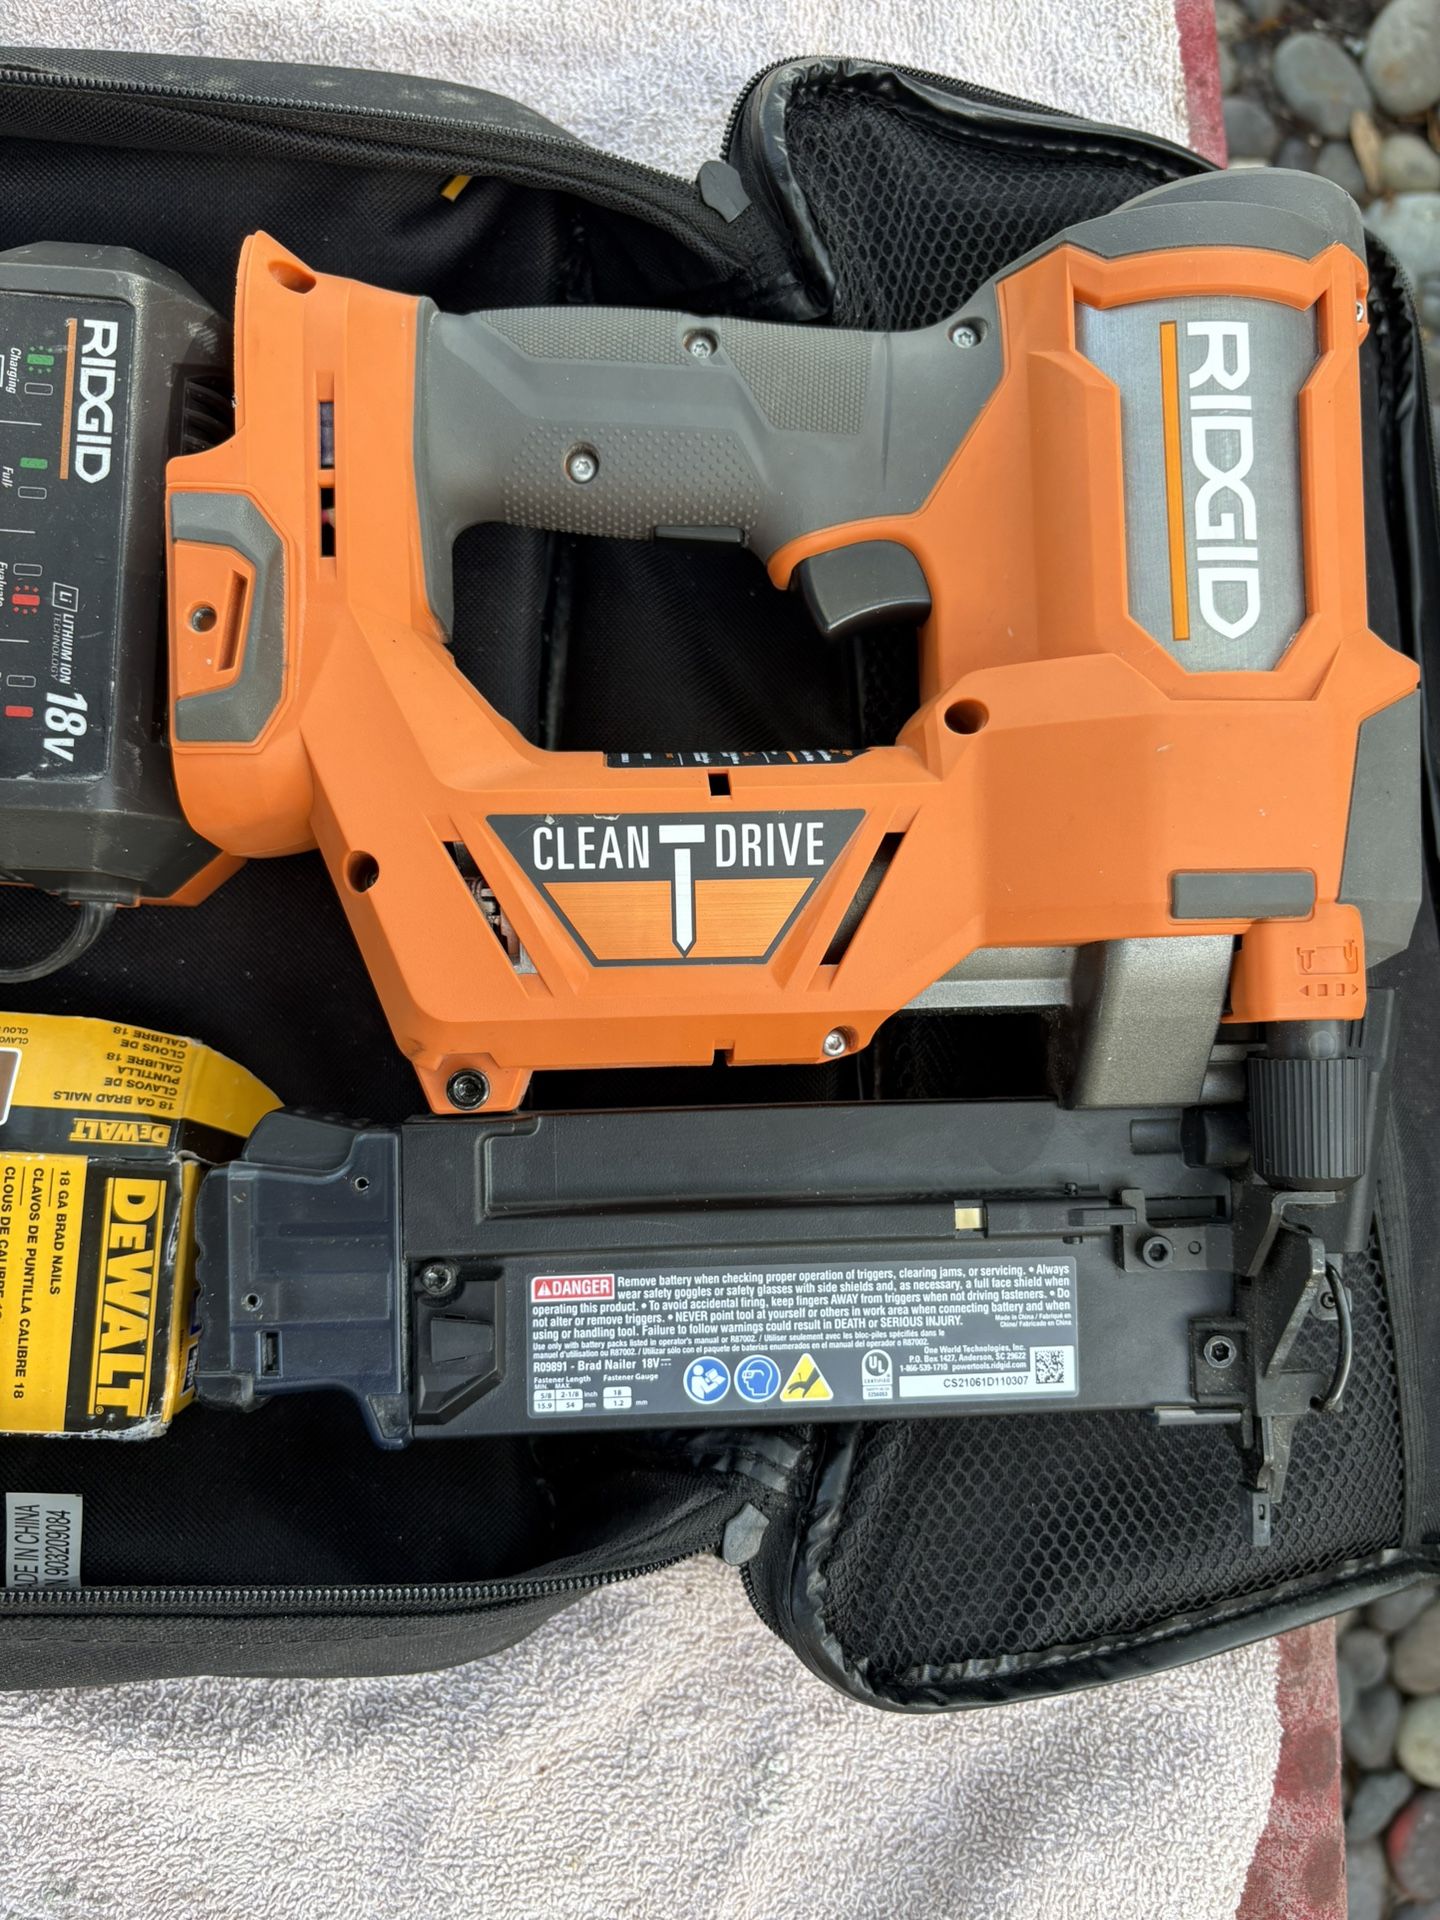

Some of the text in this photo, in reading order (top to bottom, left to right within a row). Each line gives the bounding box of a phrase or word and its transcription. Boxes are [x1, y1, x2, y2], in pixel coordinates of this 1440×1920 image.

[5, 347, 22, 394] Charging
[75, 319, 119, 483] RIDGID
[1187, 321, 1261, 640] RIDGID
[50, 612, 62, 681] TECHNOLOGY
[59, 613, 74, 685] LITHIUM ION
[532, 822, 824, 870] CLEAN DRIVE
[112, 1026, 189, 1048] CALIBRE 18
[120, 1038, 186, 1059] CLOUS DE
[106, 1052, 183, 1073] CALIBRE 18
[117, 1066, 180, 1085] PUNTILLA
[104, 1077, 178, 1096] CLAVOS DE
[53, 1090, 174, 1111] 18 GA BRAD NAILS
[69, 1119, 172, 1146] DEWALT
[0, 1166, 16, 1235] CLOUS DE
[49, 1170, 71, 1296] 18 GA BRAD NAILS
[13, 1167, 44, 1399] CLAVOS DE PUNTILLA CALIBRE 18
[552, 1279, 609, 1295] DANGER
[617, 1263, 1070, 1287] Remove battery when checking proper operation of triggers, clearing jams, or servicing. Always
[617, 1275, 1070, 1300] wear safety goggles or safety glasses with side shields and, as necessary, a full face shield when
[97, 1177, 161, 1416] DEWALT
[532, 1287, 1070, 1316] operating this product. To avoid accidental firing, keep fingers AWAY from triggers when not driving fasteners. Do
[532, 1299, 1072, 1327] not alter or remove triggers. NEVER point tool at yourself or others in work area when connecting battery and when
[533, 1315, 964, 1341] using or handling tool. Failure to follow warnings could result in DEATH or SERIOUS INJURY.
[923, 1346, 938, 1354] One
[939, 1345, 961, 1354] World
[1012, 1343, 1025, 1351] Inc.
[533, 1358, 659, 1372] R09891 Brad Nailer 18V
[634, 1373, 658, 1381] Gauge
[534, 1375, 591, 1384] Fastener Length
[943, 1375, 1028, 1388] CS21061D110307
[14, 1505, 40, 1561] IN CHINA
[44, 1510, 71, 1577] 903209084
